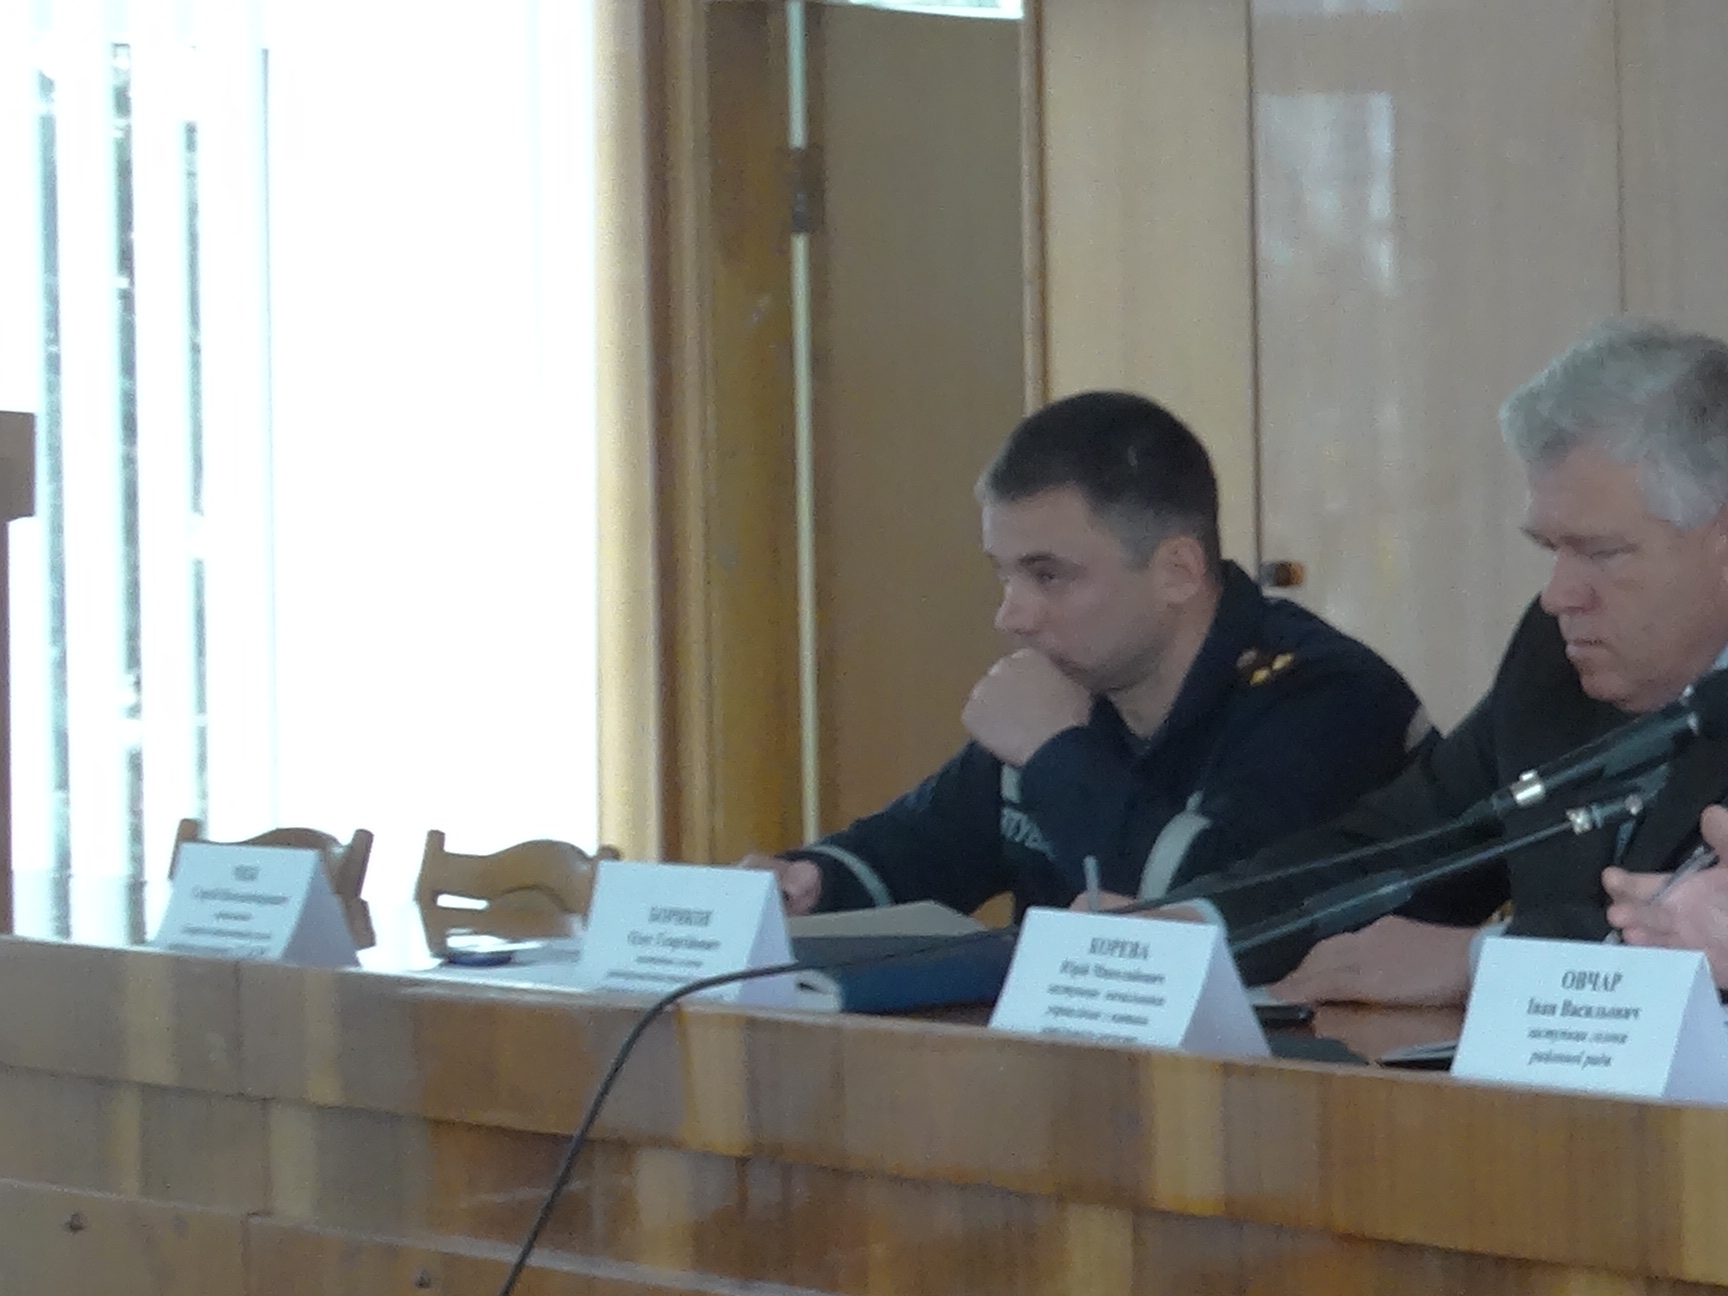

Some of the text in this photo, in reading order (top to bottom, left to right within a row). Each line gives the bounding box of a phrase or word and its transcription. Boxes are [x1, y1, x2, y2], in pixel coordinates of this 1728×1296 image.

[1561, 970, 1624, 993] ОВЧАР
[1527, 998, 1643, 1020] Іван Васильович
